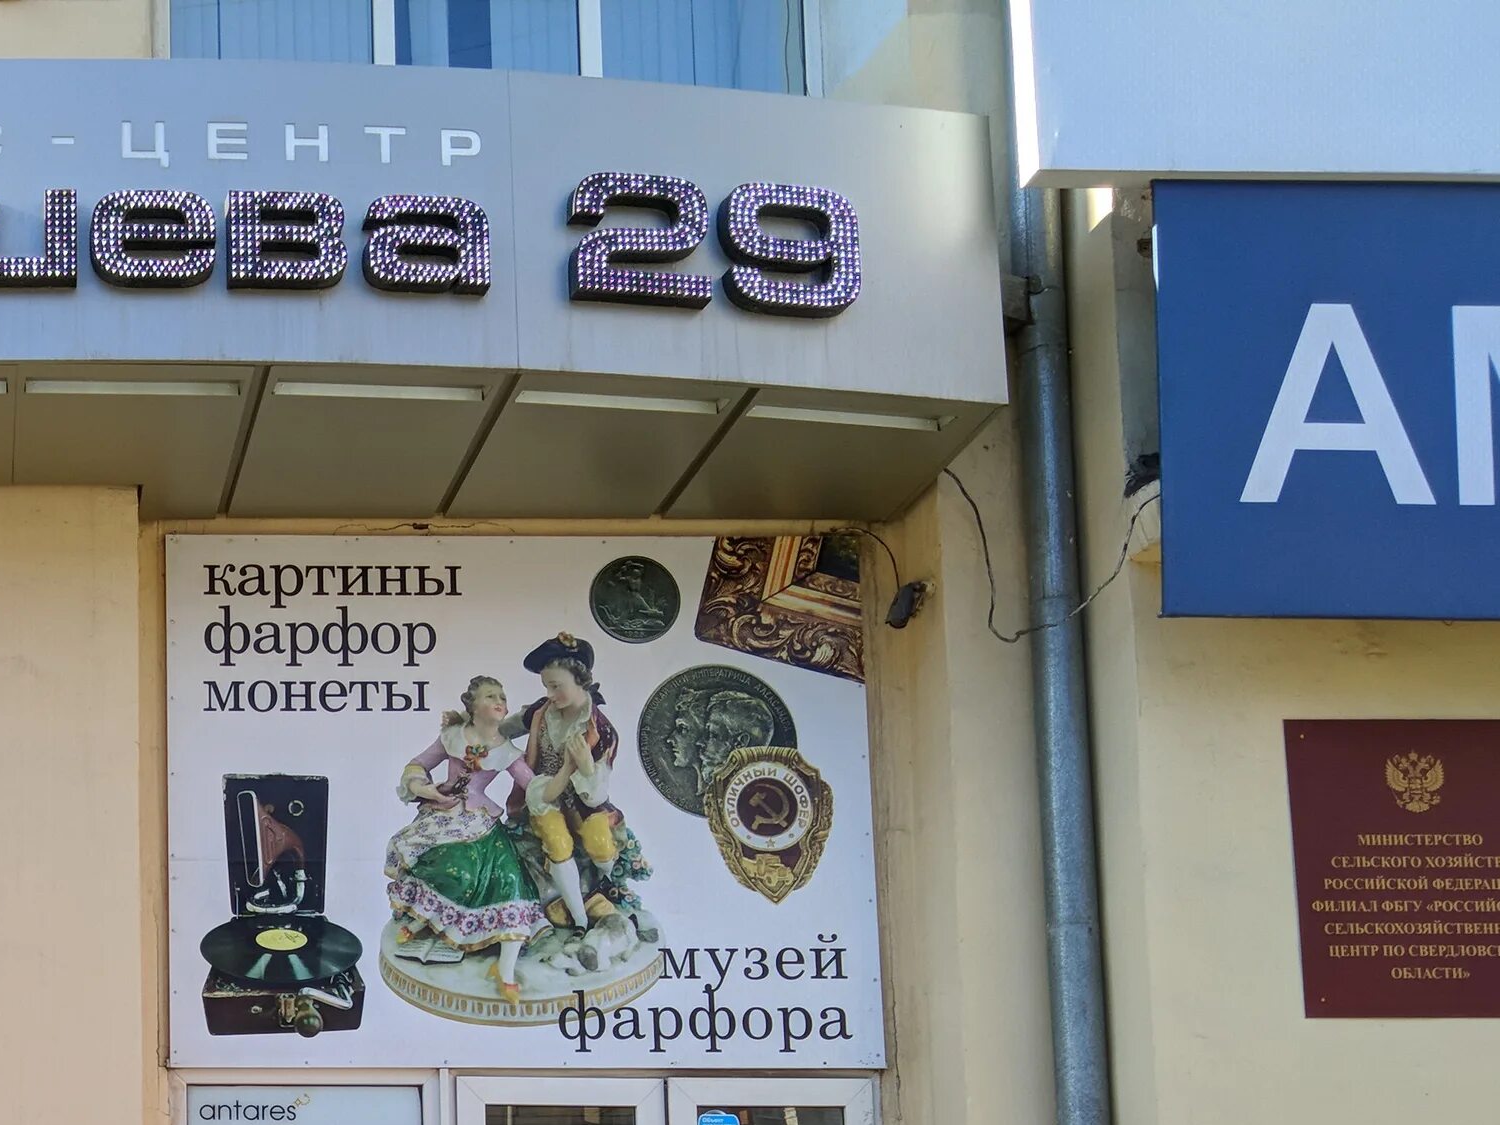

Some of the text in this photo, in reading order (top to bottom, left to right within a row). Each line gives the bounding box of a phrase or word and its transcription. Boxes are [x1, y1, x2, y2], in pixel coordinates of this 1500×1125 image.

[565, 171, 861, 319] 29
[202, 562, 463, 610] картины
[202, 605, 438, 667] фарфор
[202, 678, 431, 714] монеты
[725, 767, 778, 829] ОТЛИЧНЫЙ
[782, 770, 813, 829] ШОФЕР
[1357, 833, 1483, 846] МИНИСТЕРСТВО
[1330, 855, 1422, 868] СЕЛЬСКОГО
[1323, 876, 1429, 890] РОССИЙСКОЙ
[1311, 900, 1378, 912] ФИЛИАЛ
[1381, 900, 1422, 912] ФБГУ
[658, 933, 850, 996] музей
[1329, 945, 1500, 958] ЦЕНТР ПО СВЕРДЛОВС
[1390, 967, 1471, 980] ОБЛАСТИ»
[557, 990, 853, 1053] фарфора
[199, 1100, 297, 1122] antares
